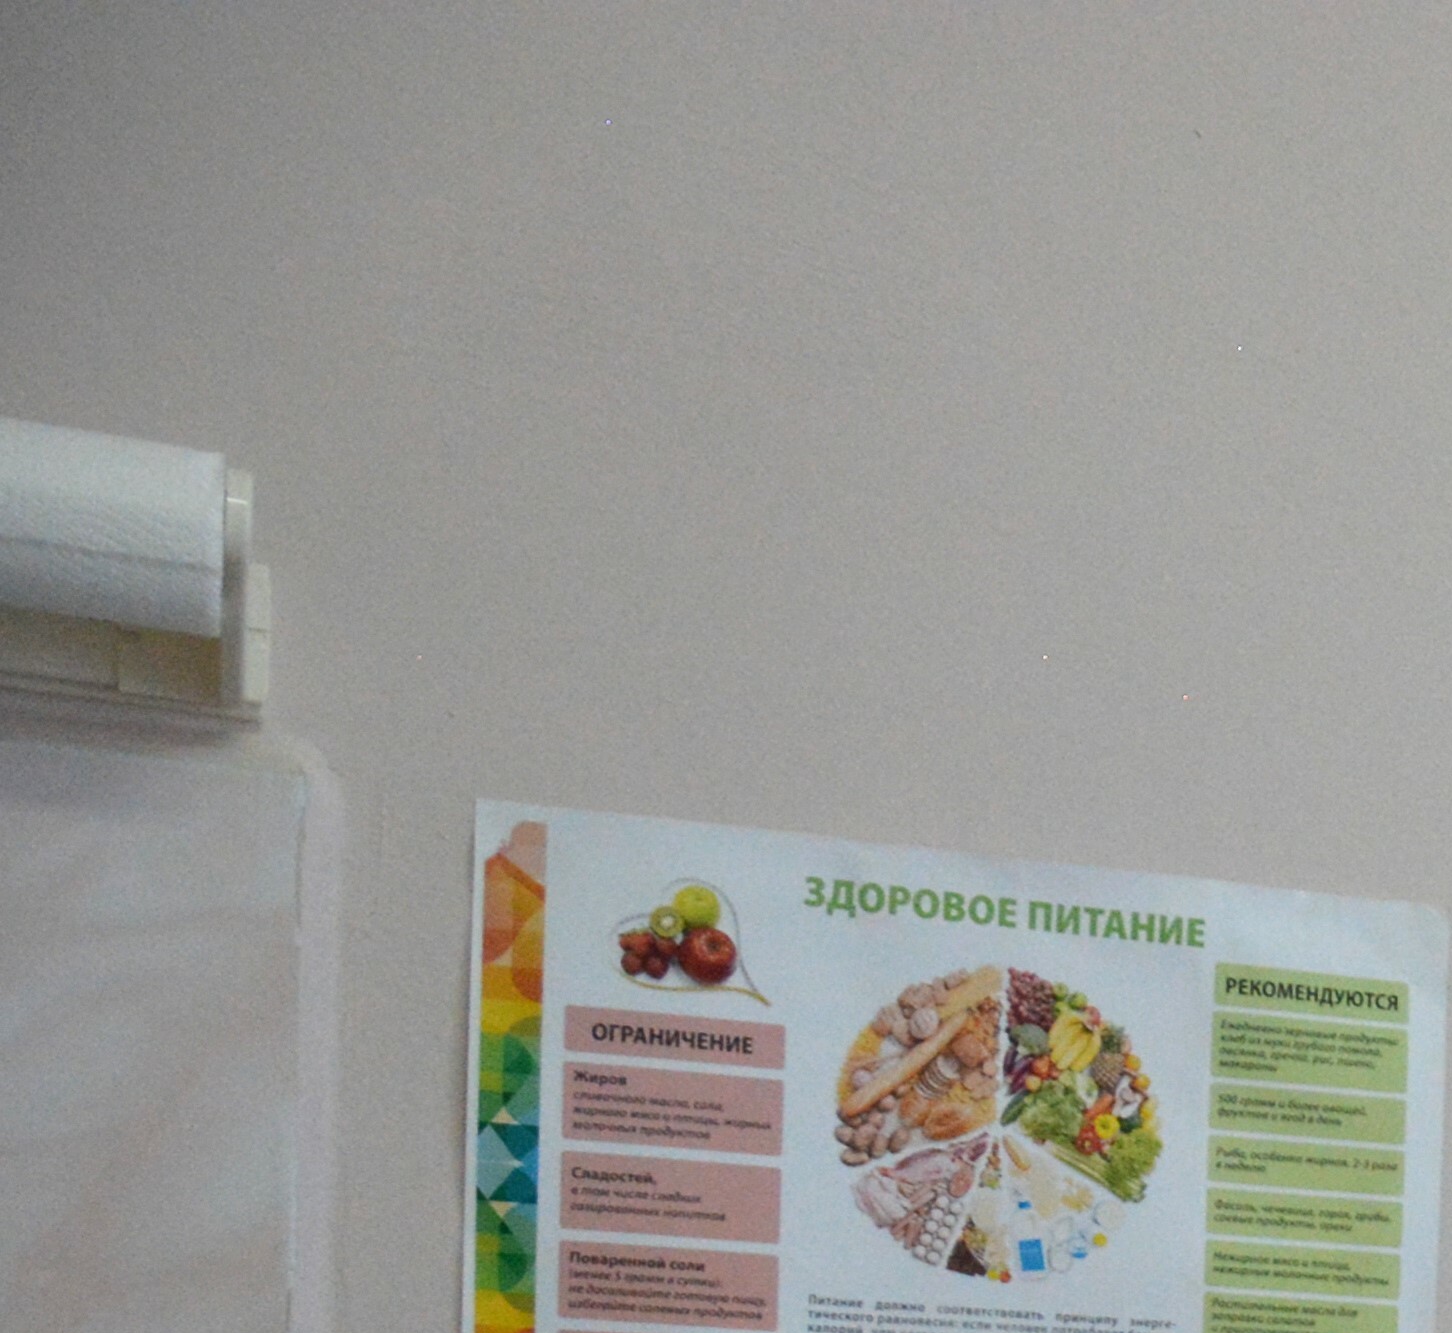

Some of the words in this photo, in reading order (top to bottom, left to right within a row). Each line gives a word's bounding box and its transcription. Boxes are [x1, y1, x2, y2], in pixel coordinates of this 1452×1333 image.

[803, 875, 1017, 929] ЗДОРОВОЕ
[1026, 900, 1207, 949] ПИТАНИЕ
[1225, 976, 1400, 1013] РЕКОМЕНДУЮТСЯ
[591, 1022, 755, 1055] ОГРАНИЧЕНИЕ
[573, 1070, 628, 1087] Жиров
[569, 1251, 667, 1270] Поваренной
[669, 1259, 706, 1273] соли
[807, 1309, 874, 1323] тического
[961, 1319, 992, 1330] если
[808, 1294, 864, 1308] Питание
[874, 1300, 926, 1312] должно
[936, 1305, 1045, 1320] соответствовать
[1054, 1312, 1119, 1328] принципу
